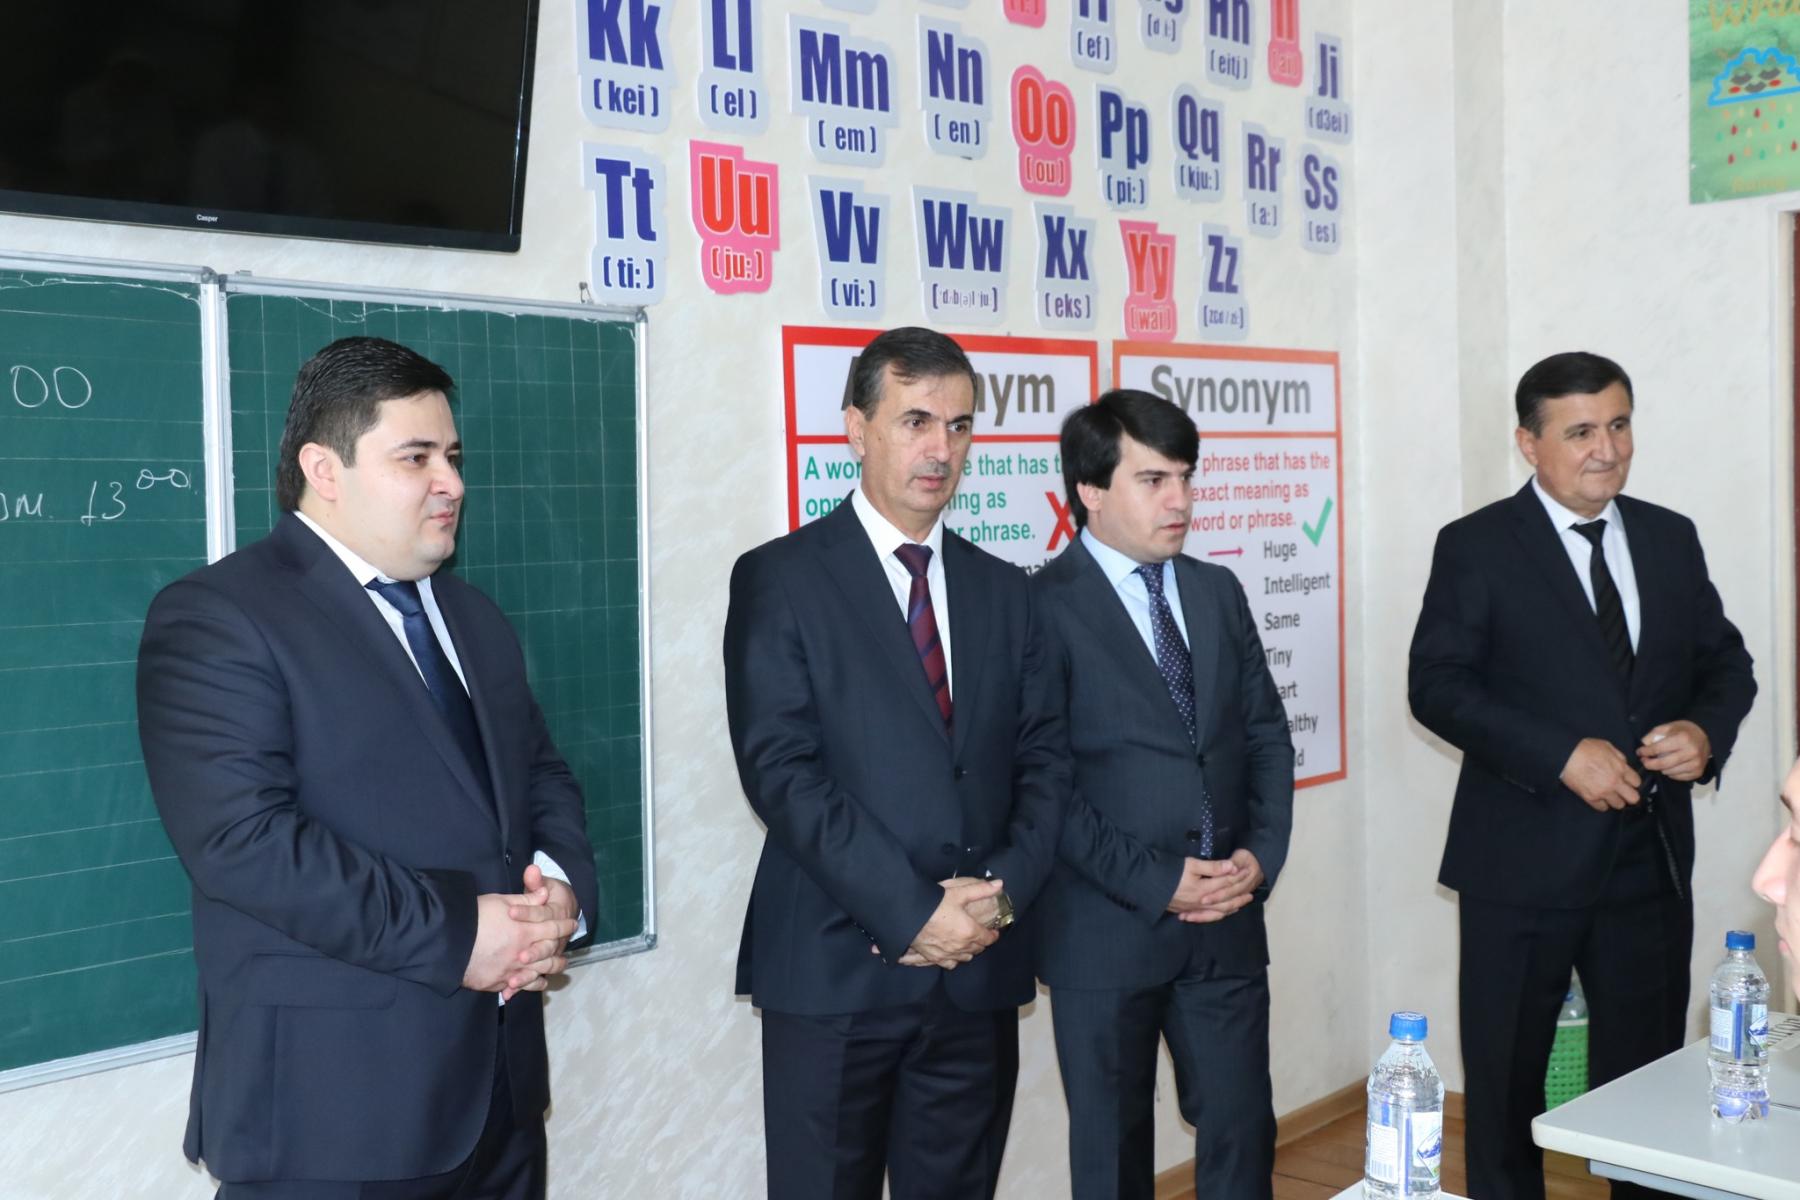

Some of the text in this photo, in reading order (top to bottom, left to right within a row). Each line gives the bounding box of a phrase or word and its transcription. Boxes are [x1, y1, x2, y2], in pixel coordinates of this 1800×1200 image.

[587, 0, 664, 70] Kk
[799, 28, 890, 112] Mm
[927, 29, 984, 105] Nn
[593, 78, 659, 117] (kei)
[1017, 77, 1069, 146] Oo
[818, 119, 876, 153] (em)
[934, 113, 981, 145] (en)
[1099, 90, 1150, 170] Pp
[1177, 94, 1220, 163] Qq
[1247, 132, 1281, 193] Rr
[1304, 153, 1338, 211] Ss
[196, 213, 219, 223] Casper
[595, 157, 657, 242] Tt
[700, 155, 770, 236] Uu
[819, 189, 880, 264] Vv
[922, 198, 1005, 273] Ww
[1043, 214, 1090, 281] Xx
[1127, 231, 1170, 301] Yy
[1207, 234, 1239, 295] Zz
[1045, 292, 1092, 320] (eks)
[1150, 363, 1312, 426] Synonym
[804, 454, 821, 480] A
[825, 460, 863, 480] wor
[978, 452, 1013, 476] that
[1018, 452, 1049, 475] has
[1191, 480, 1310, 503] exact meaning as
[1203, 450, 1331, 476] phrase that has the
[986, 490, 1008, 509] as
[1191, 509, 1226, 532] word
[1230, 512, 1244, 530] or
[970, 520, 1037, 543] phrase.
[1264, 541, 1298, 563] Huge
[1264, 572, 1332, 595] Intelligent
[1265, 612, 1301, 631] Same
[1265, 647, 1293, 668] Tiny
